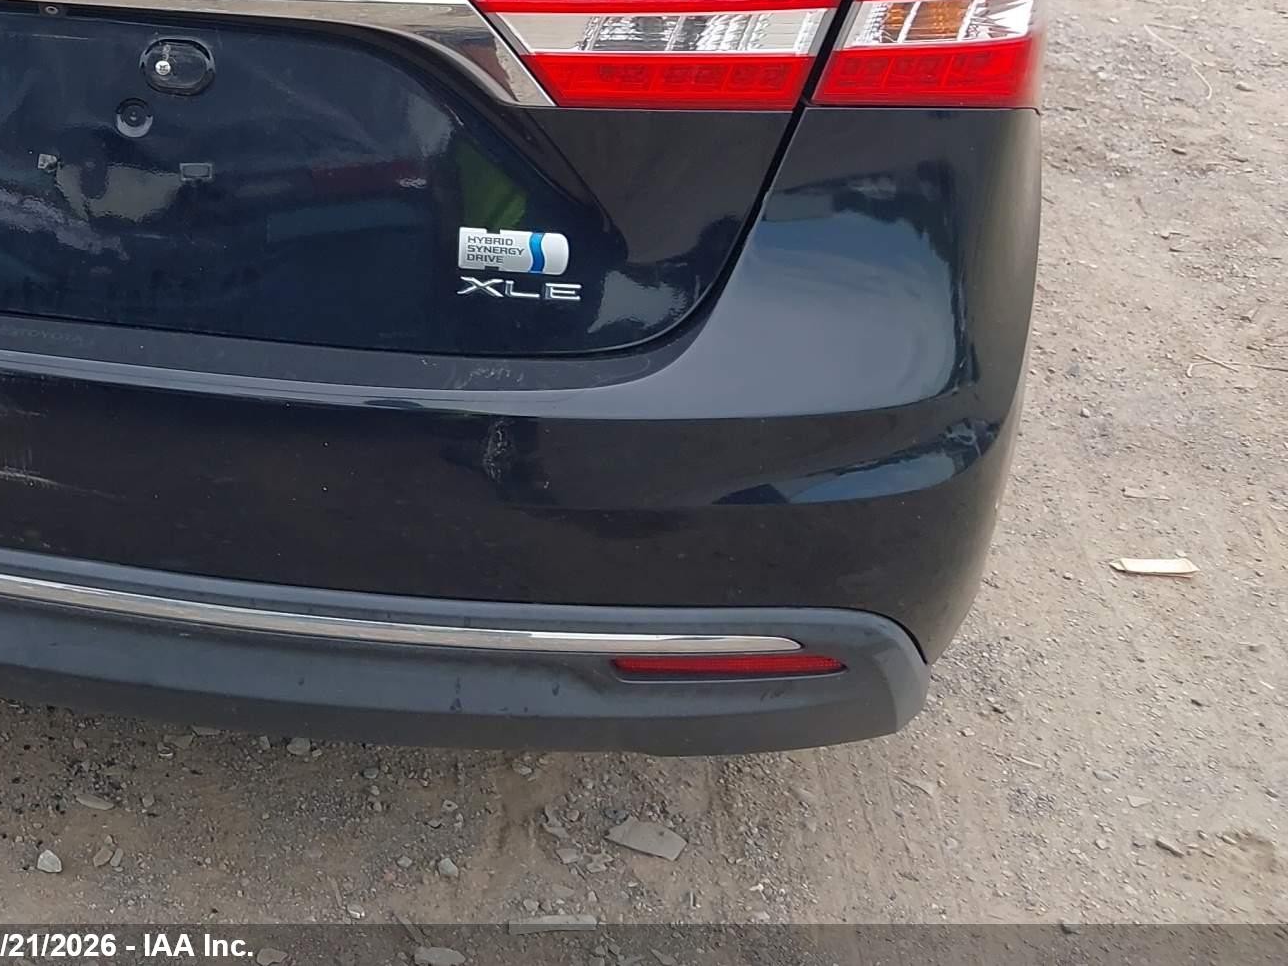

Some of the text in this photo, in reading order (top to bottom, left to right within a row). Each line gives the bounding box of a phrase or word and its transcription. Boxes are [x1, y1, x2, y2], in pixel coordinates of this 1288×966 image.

[467, 235, 514, 246] HYBRID
[467, 245, 525, 256] SYNERGY
[466, 253, 504, 264] DRIVE
[456, 275, 582, 301] XLE
